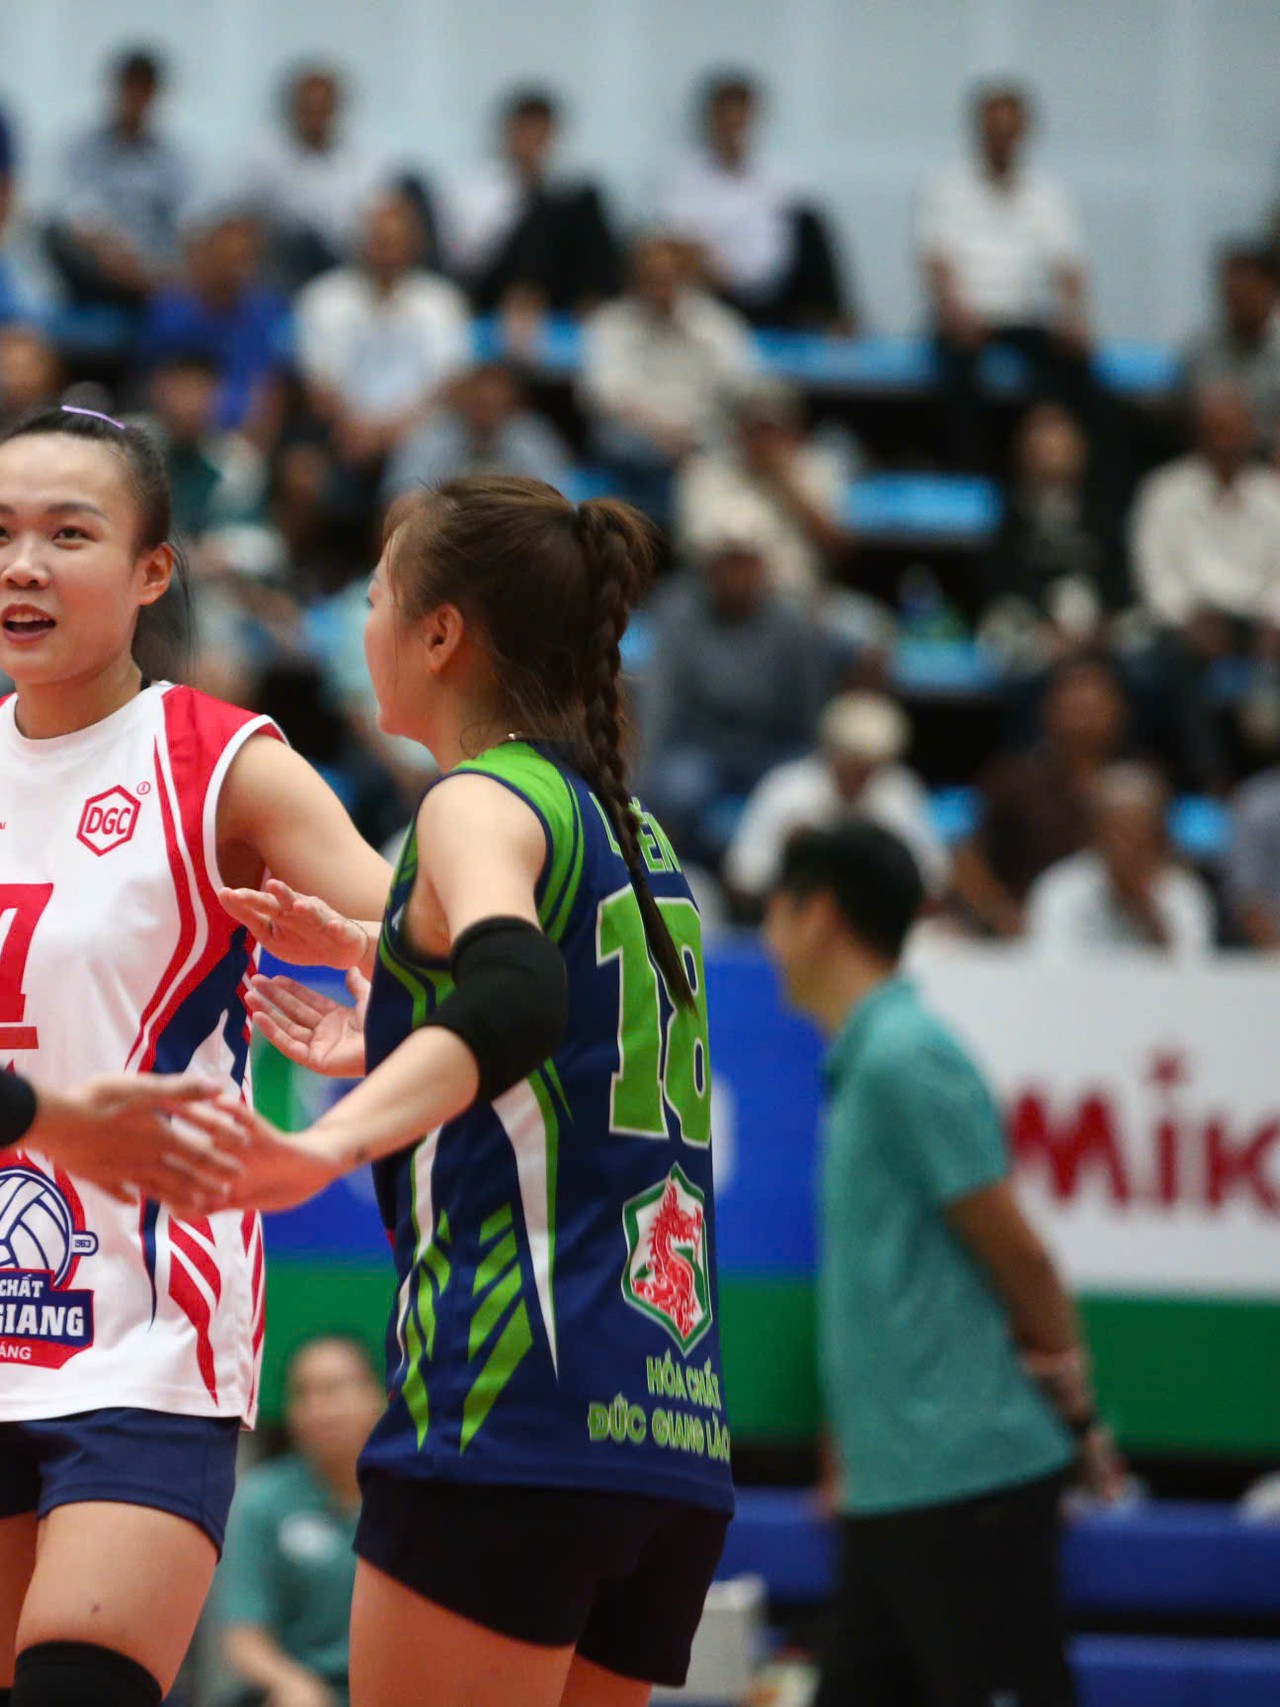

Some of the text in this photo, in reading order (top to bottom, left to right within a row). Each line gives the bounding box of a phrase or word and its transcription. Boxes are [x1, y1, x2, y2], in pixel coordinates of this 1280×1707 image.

[85, 807, 131, 835] DGC
[596, 882, 710, 1149] 18
[588, 1391, 646, 1444] ĐỨC
